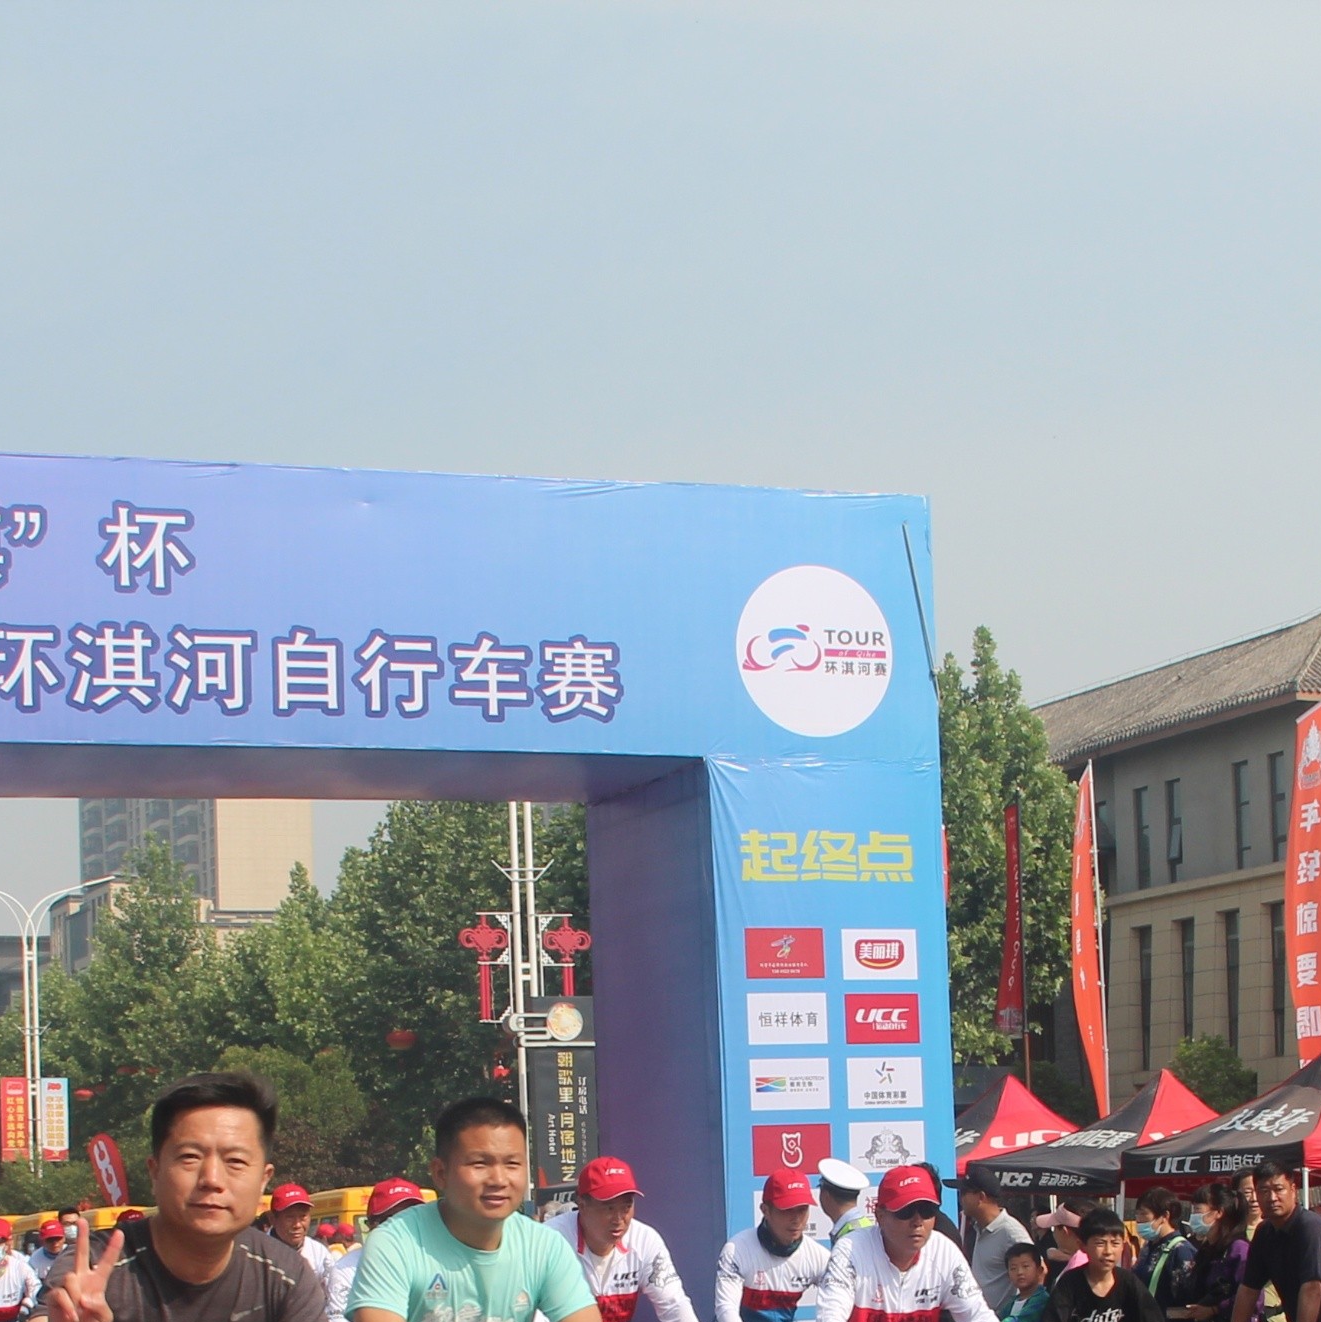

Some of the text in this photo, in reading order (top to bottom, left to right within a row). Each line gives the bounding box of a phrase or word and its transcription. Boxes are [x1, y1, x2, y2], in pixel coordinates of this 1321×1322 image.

[103, 506, 189, 588] 杯
[824, 629, 885, 646] TOUR
[825, 661, 887, 677] 环淇河赛
[740, 830, 914, 882] 起终点
[859, 942, 899, 960] 美丽琪
[759, 1012, 819, 1028] 恒祥体育
[855, 1008, 910, 1023] UCC
[864, 1091, 907, 1100] 中国体育彩票
[547, 1113, 557, 1156] Art Hotel
[990, 1130, 1072, 1149] UC
[1153, 1156, 1200, 1174] UCC
